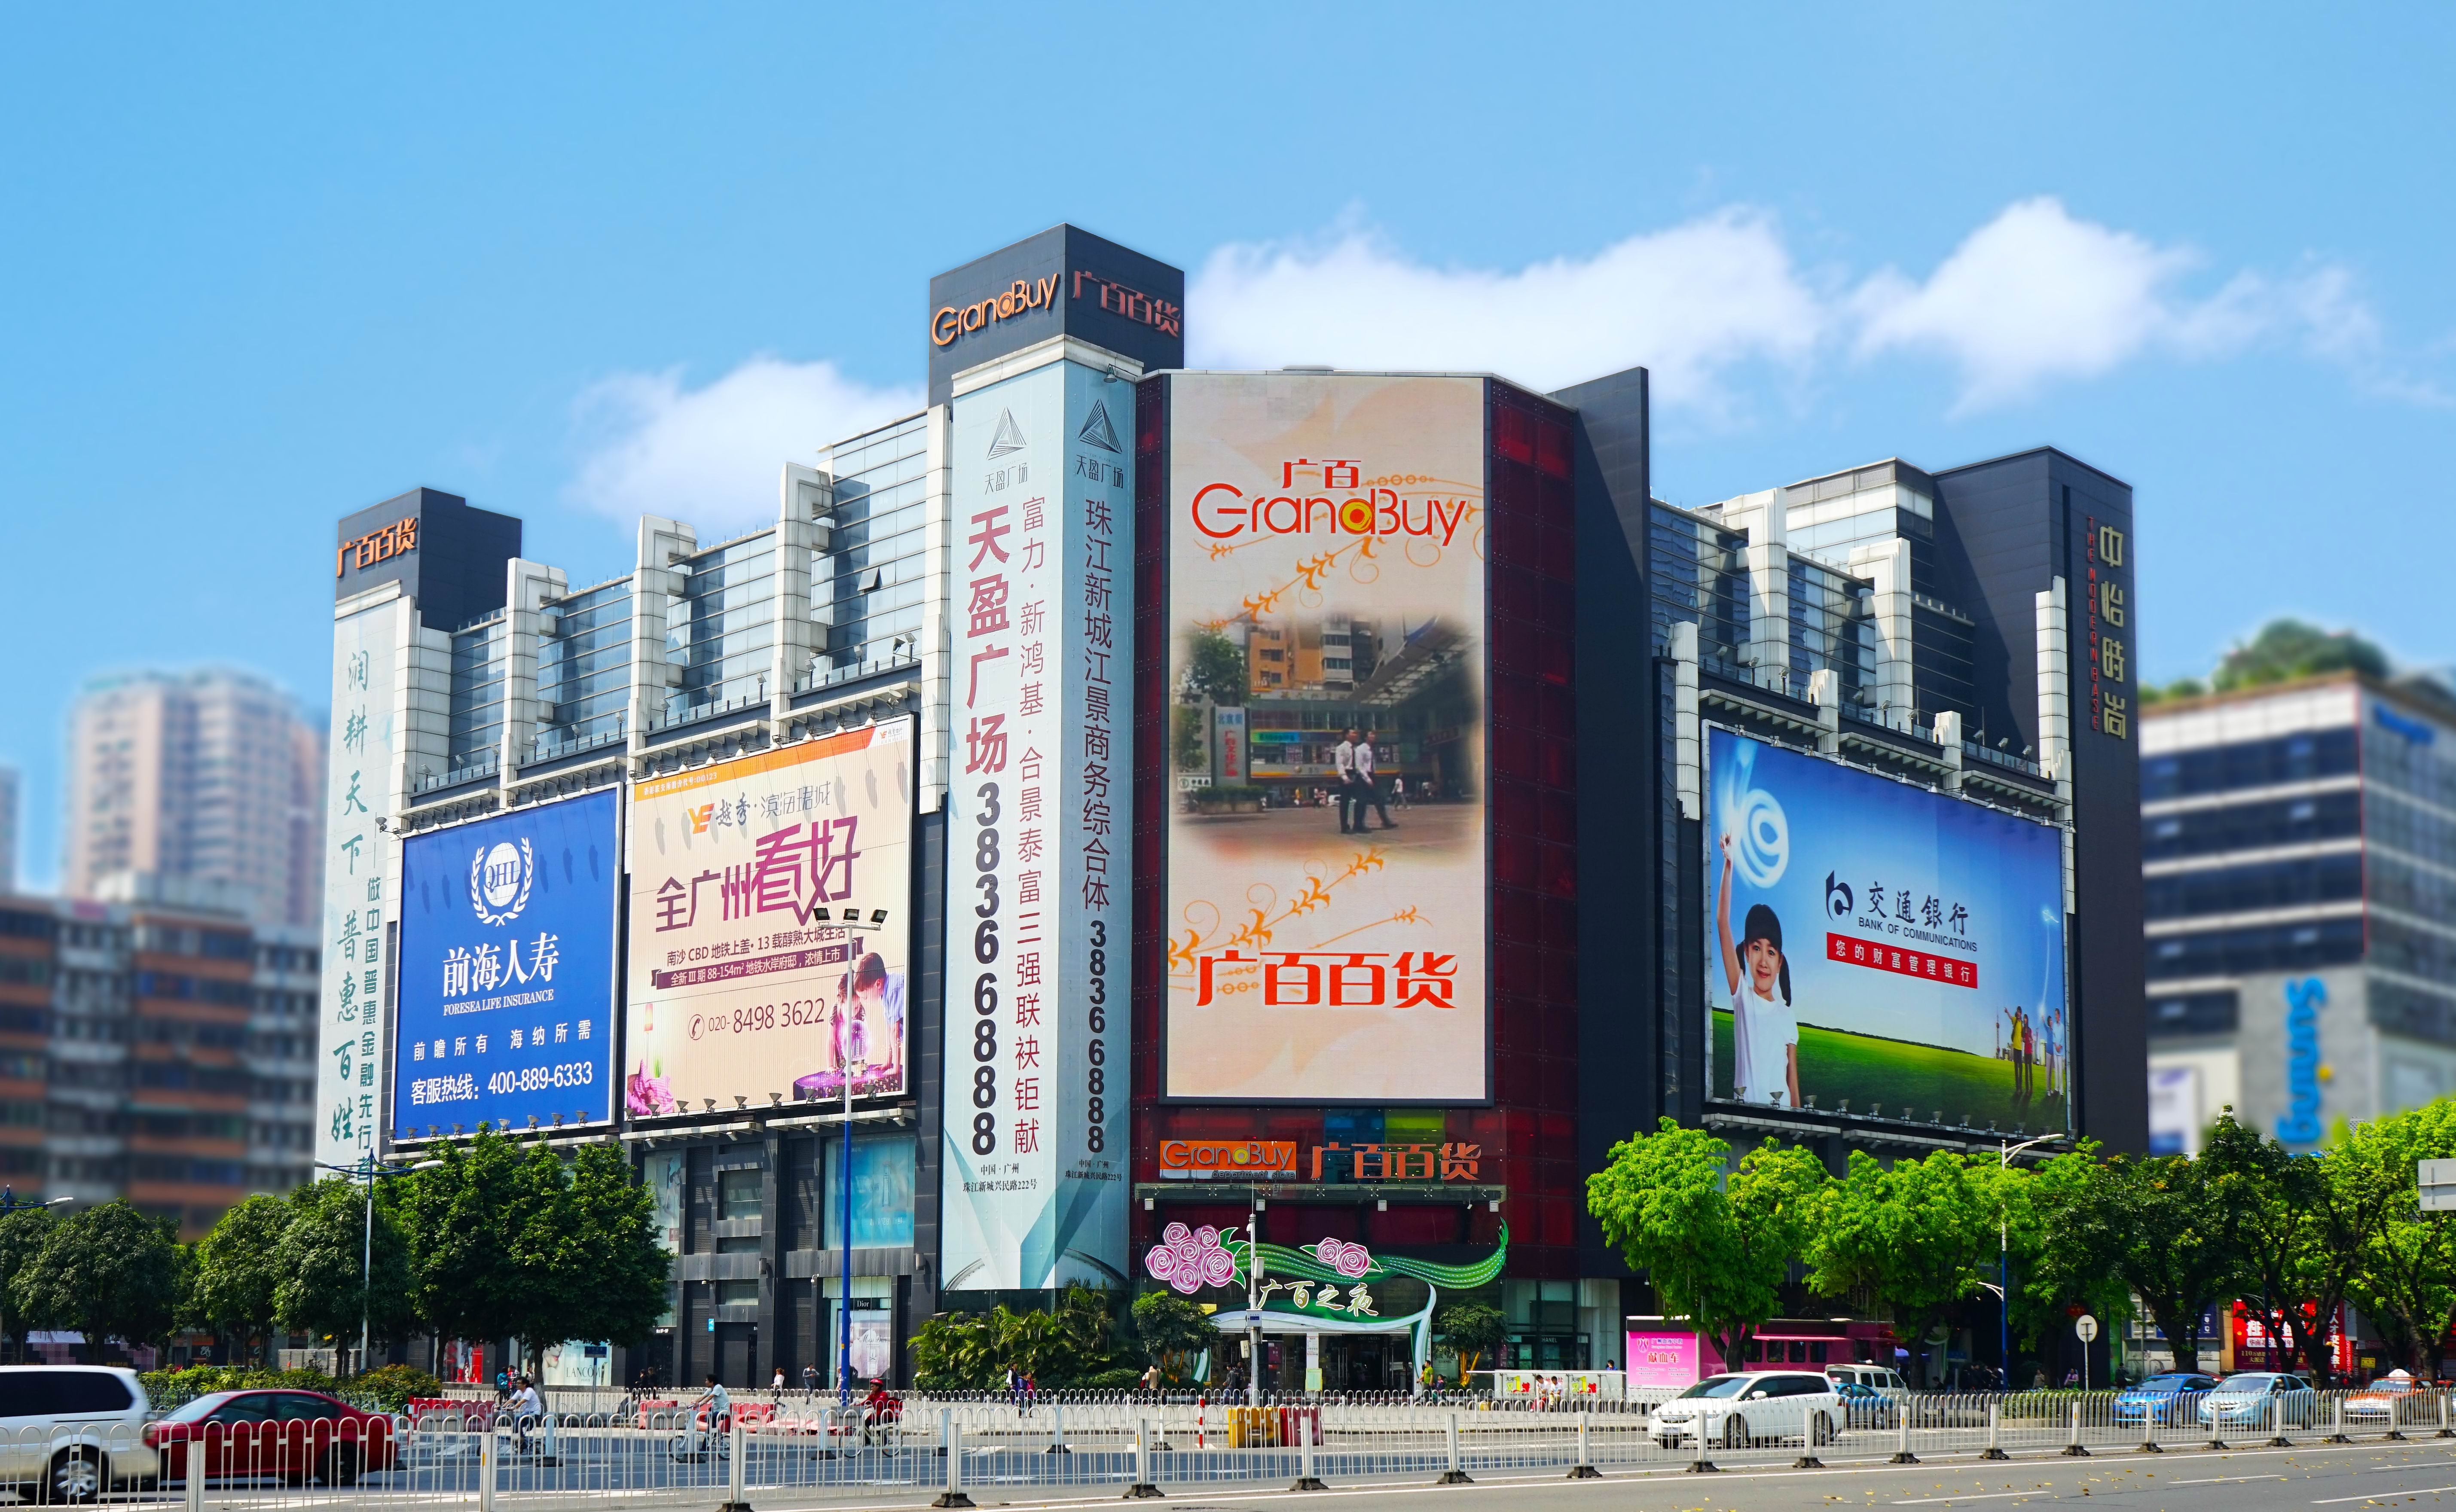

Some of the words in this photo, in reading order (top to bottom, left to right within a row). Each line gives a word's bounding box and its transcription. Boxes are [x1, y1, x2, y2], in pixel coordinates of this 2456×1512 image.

[932, 273, 1059, 346] GrandBuy
[1072, 270, 1181, 338] 广百百货
[984, 462, 1028, 495] 天盈广场
[1076, 454, 1124, 489] 天盈广场
[1282, 458, 1361, 489] 广百
[1191, 483, 1466, 546] GrandBuy
[336, 517, 418, 578] 广百百货
[2086, 516, 2095, 563] THE
[2088, 567, 2098, 663] MODERN
[965, 505, 1011, 775] 天盈广场
[1082, 498, 1113, 912] 珠江新城江景商务综合体
[2090, 667, 2099, 731] BASE
[656, 815, 862, 932] 全广州看好
[688, 946, 709, 961] CBD
[1858, 917, 1883, 932] BANK
[1888, 924, 1900, 934] OF
[1903, 927, 1977, 952] COMMUNICATIONS
[442, 932, 559, 997] 前海人寿
[1196, 950, 1458, 1009] 广百百货
[1836, 939, 1970, 982] 您的财富管理银行
[443, 1001, 480, 1016] FORESEA
[482, 997, 501, 1009] LIFE
[503, 989, 554, 1008] INSURANCE
[781, 997, 825, 1027] 3622
[488, 1061, 593, 1095] 400-889-6333
[1163, 1141, 1293, 1169] GrandBuy
[1212, 1169, 1268, 1179] department
[1271, 1169, 1295, 1179] store
[1310, 1142, 1482, 1180] 广百百货
[1256, 1278, 1379, 1317] 广百之夜
[1648, 1352, 1679, 1363] 献血车
